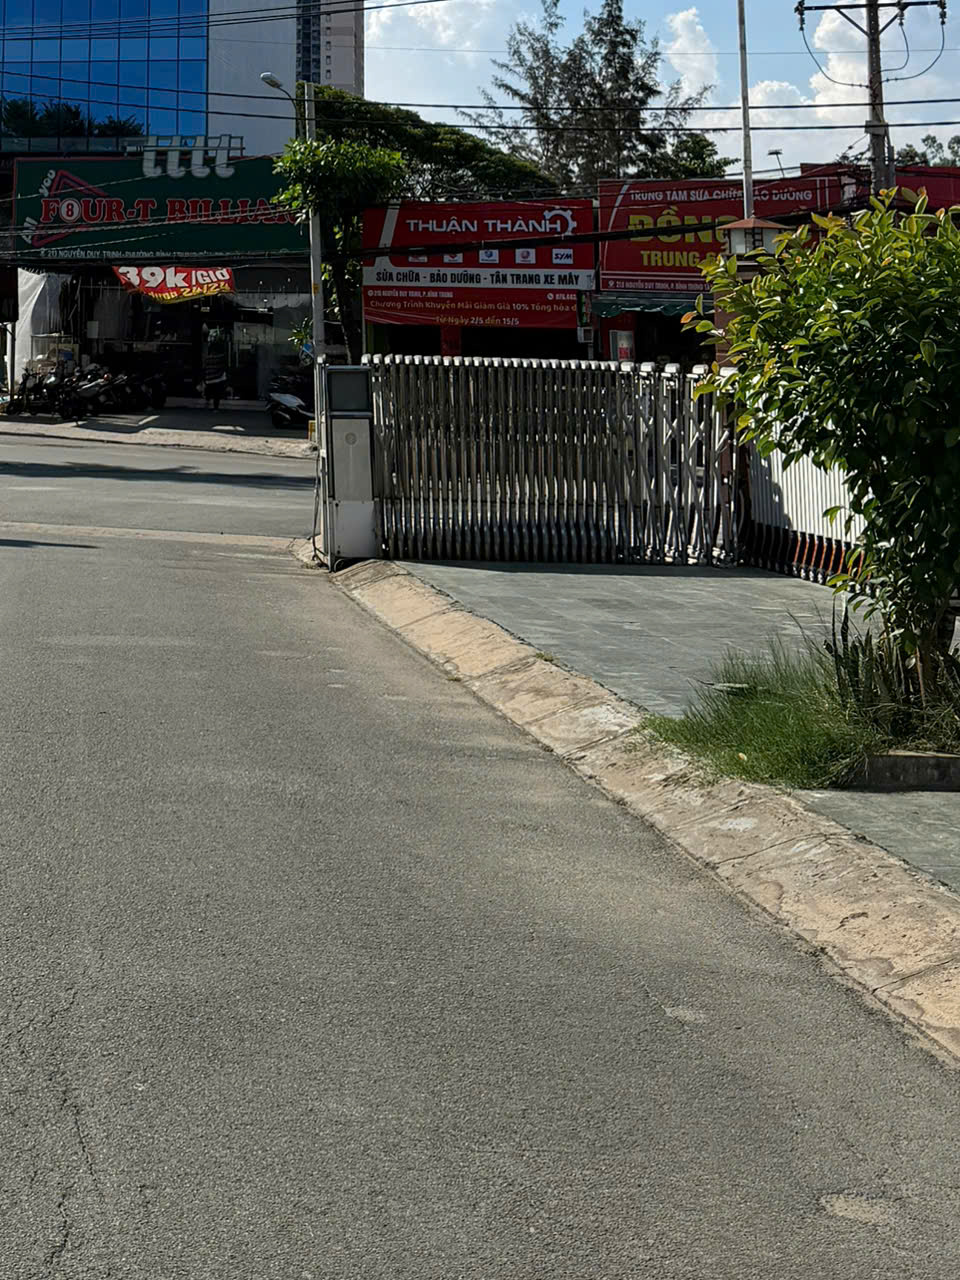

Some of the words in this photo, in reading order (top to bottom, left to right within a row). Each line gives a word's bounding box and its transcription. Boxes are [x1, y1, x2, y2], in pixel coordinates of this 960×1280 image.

[405, 216, 478, 235] THUẬN
[483, 215, 561, 232] THÀNH
[554, 252, 572, 260] SYM
[640, 250, 701, 268] TRUNG
[376, 268, 394, 282] SỬA
[396, 270, 420, 283] CHỮA
[429, 269, 448, 283] BẢO
[450, 270, 481, 284] DƯỠNG
[510, 273, 541, 285] TRANG
[544, 274, 556, 285] XE
